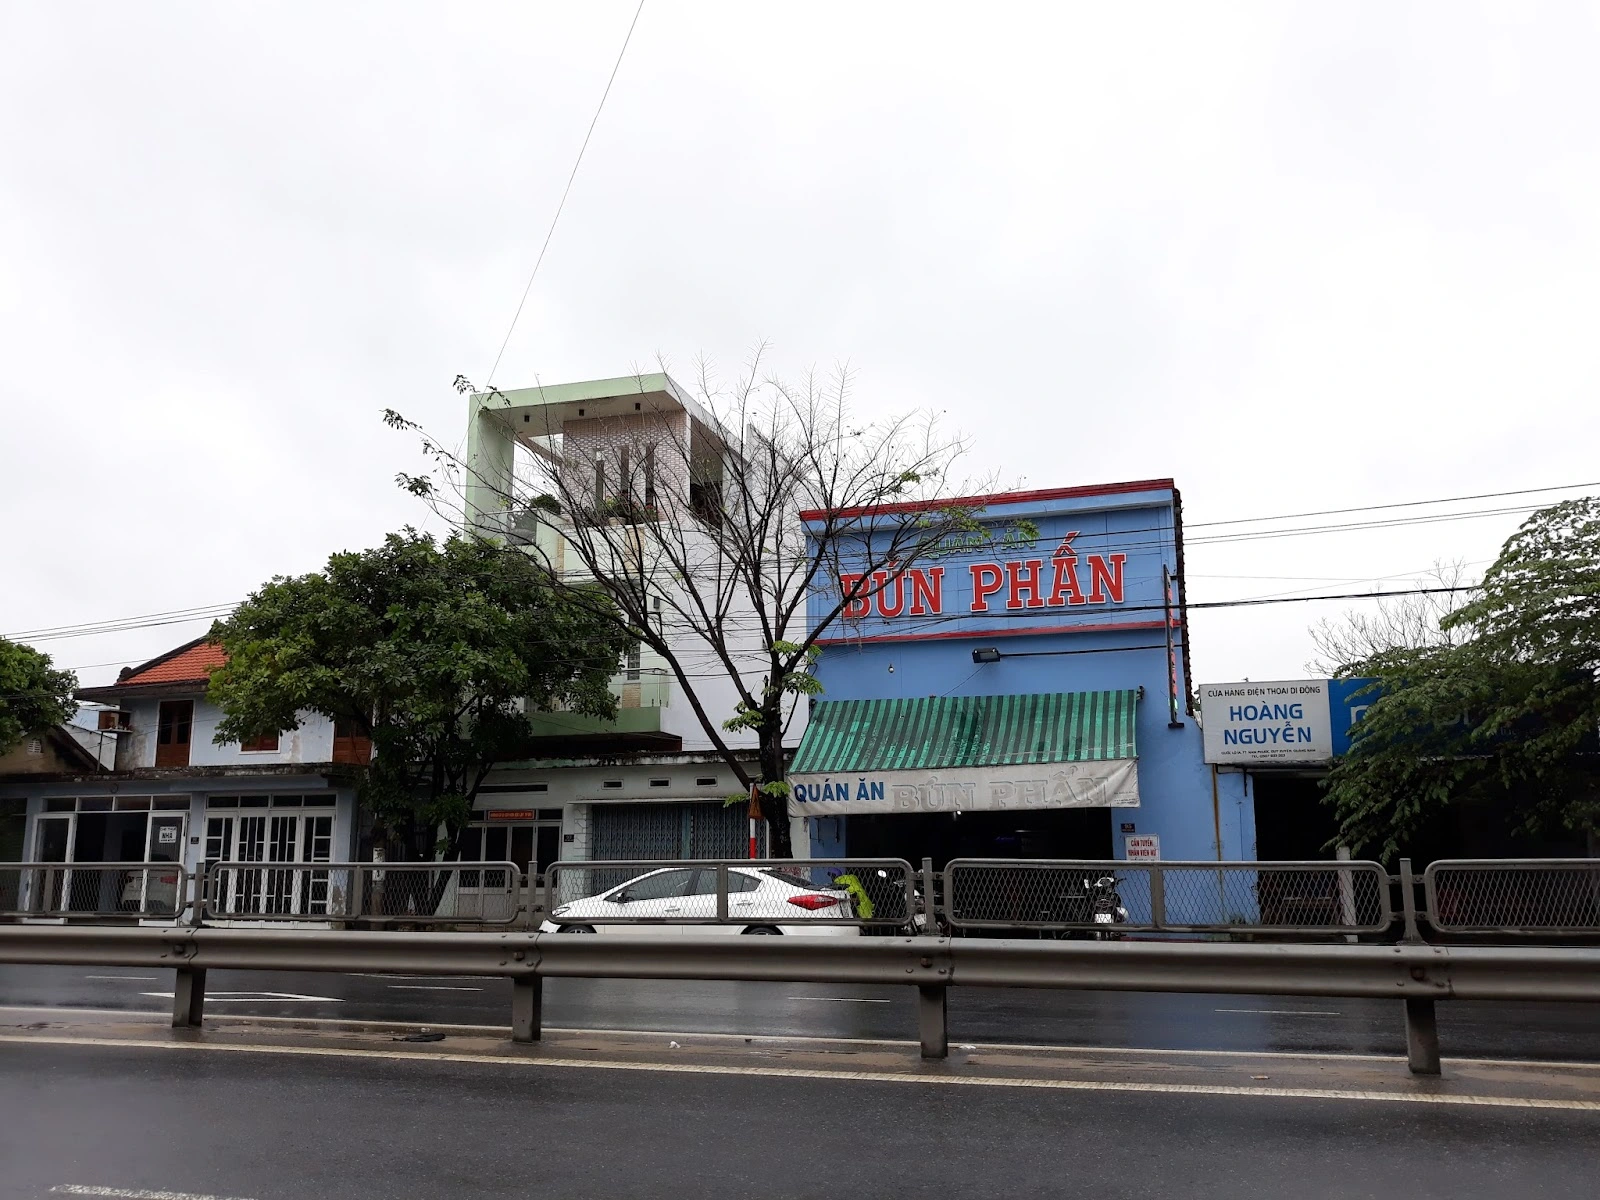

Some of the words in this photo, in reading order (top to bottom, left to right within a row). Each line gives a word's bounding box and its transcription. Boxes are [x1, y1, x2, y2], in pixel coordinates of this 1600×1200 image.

[840, 558, 945, 619] BÚN
[969, 531, 1127, 612] PHẤN
[1208, 689, 1223, 697] CỬA
[1224, 687, 1245, 697] HÀNG
[1247, 686, 1265, 696] ĐIỆN
[1290, 686, 1298, 694] DI
[1299, 685, 1321, 695] ĐỘNG
[1230, 701, 1303, 721] HOÀNG
[1224, 721, 1312, 745] NGUYỄN
[794, 778, 850, 803] QUÁN
[856, 777, 885, 801] ĂN
[891, 776, 976, 813] BÚN
